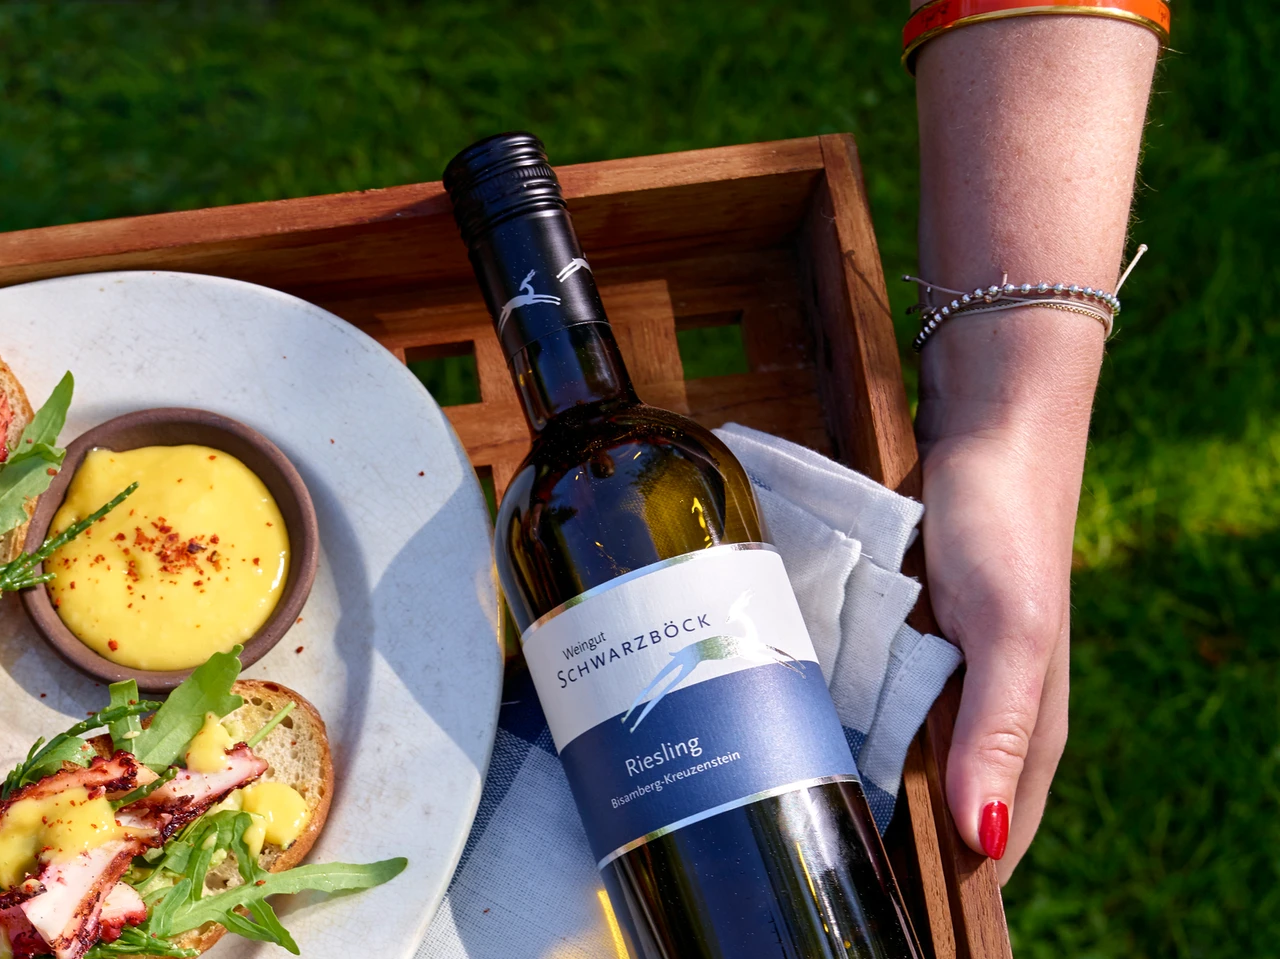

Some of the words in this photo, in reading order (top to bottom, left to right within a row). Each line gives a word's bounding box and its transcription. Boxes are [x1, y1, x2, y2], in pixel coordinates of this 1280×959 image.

[557, 613, 711, 689] SCHWARZBÖCK
[562, 631, 606, 660] Weingut
[611, 751, 740, 809] Bisamberg-Kreuzenstein
[625, 737, 702, 777] Riesling
